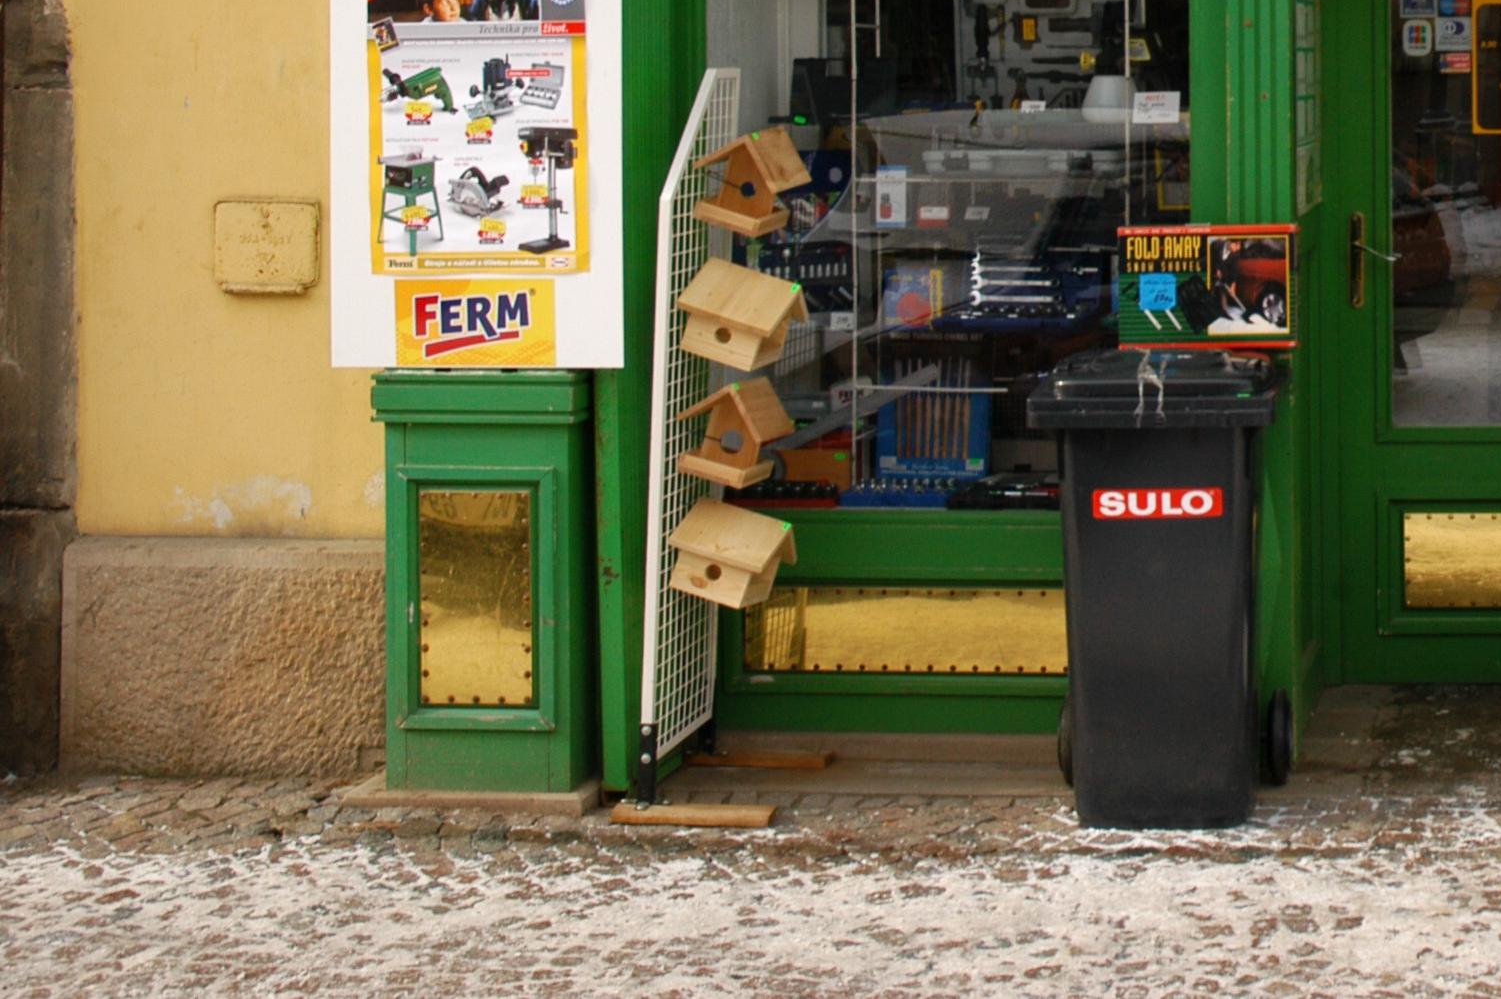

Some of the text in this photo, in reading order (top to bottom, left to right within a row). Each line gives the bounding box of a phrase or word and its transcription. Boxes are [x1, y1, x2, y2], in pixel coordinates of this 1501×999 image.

[479, 24, 521, 35] Technika
[522, 27, 539, 36] pro
[1126, 260, 1201, 273] SNOW SHOVEL
[413, 292, 530, 337] FERM
[1099, 490, 1214, 516] SULO
